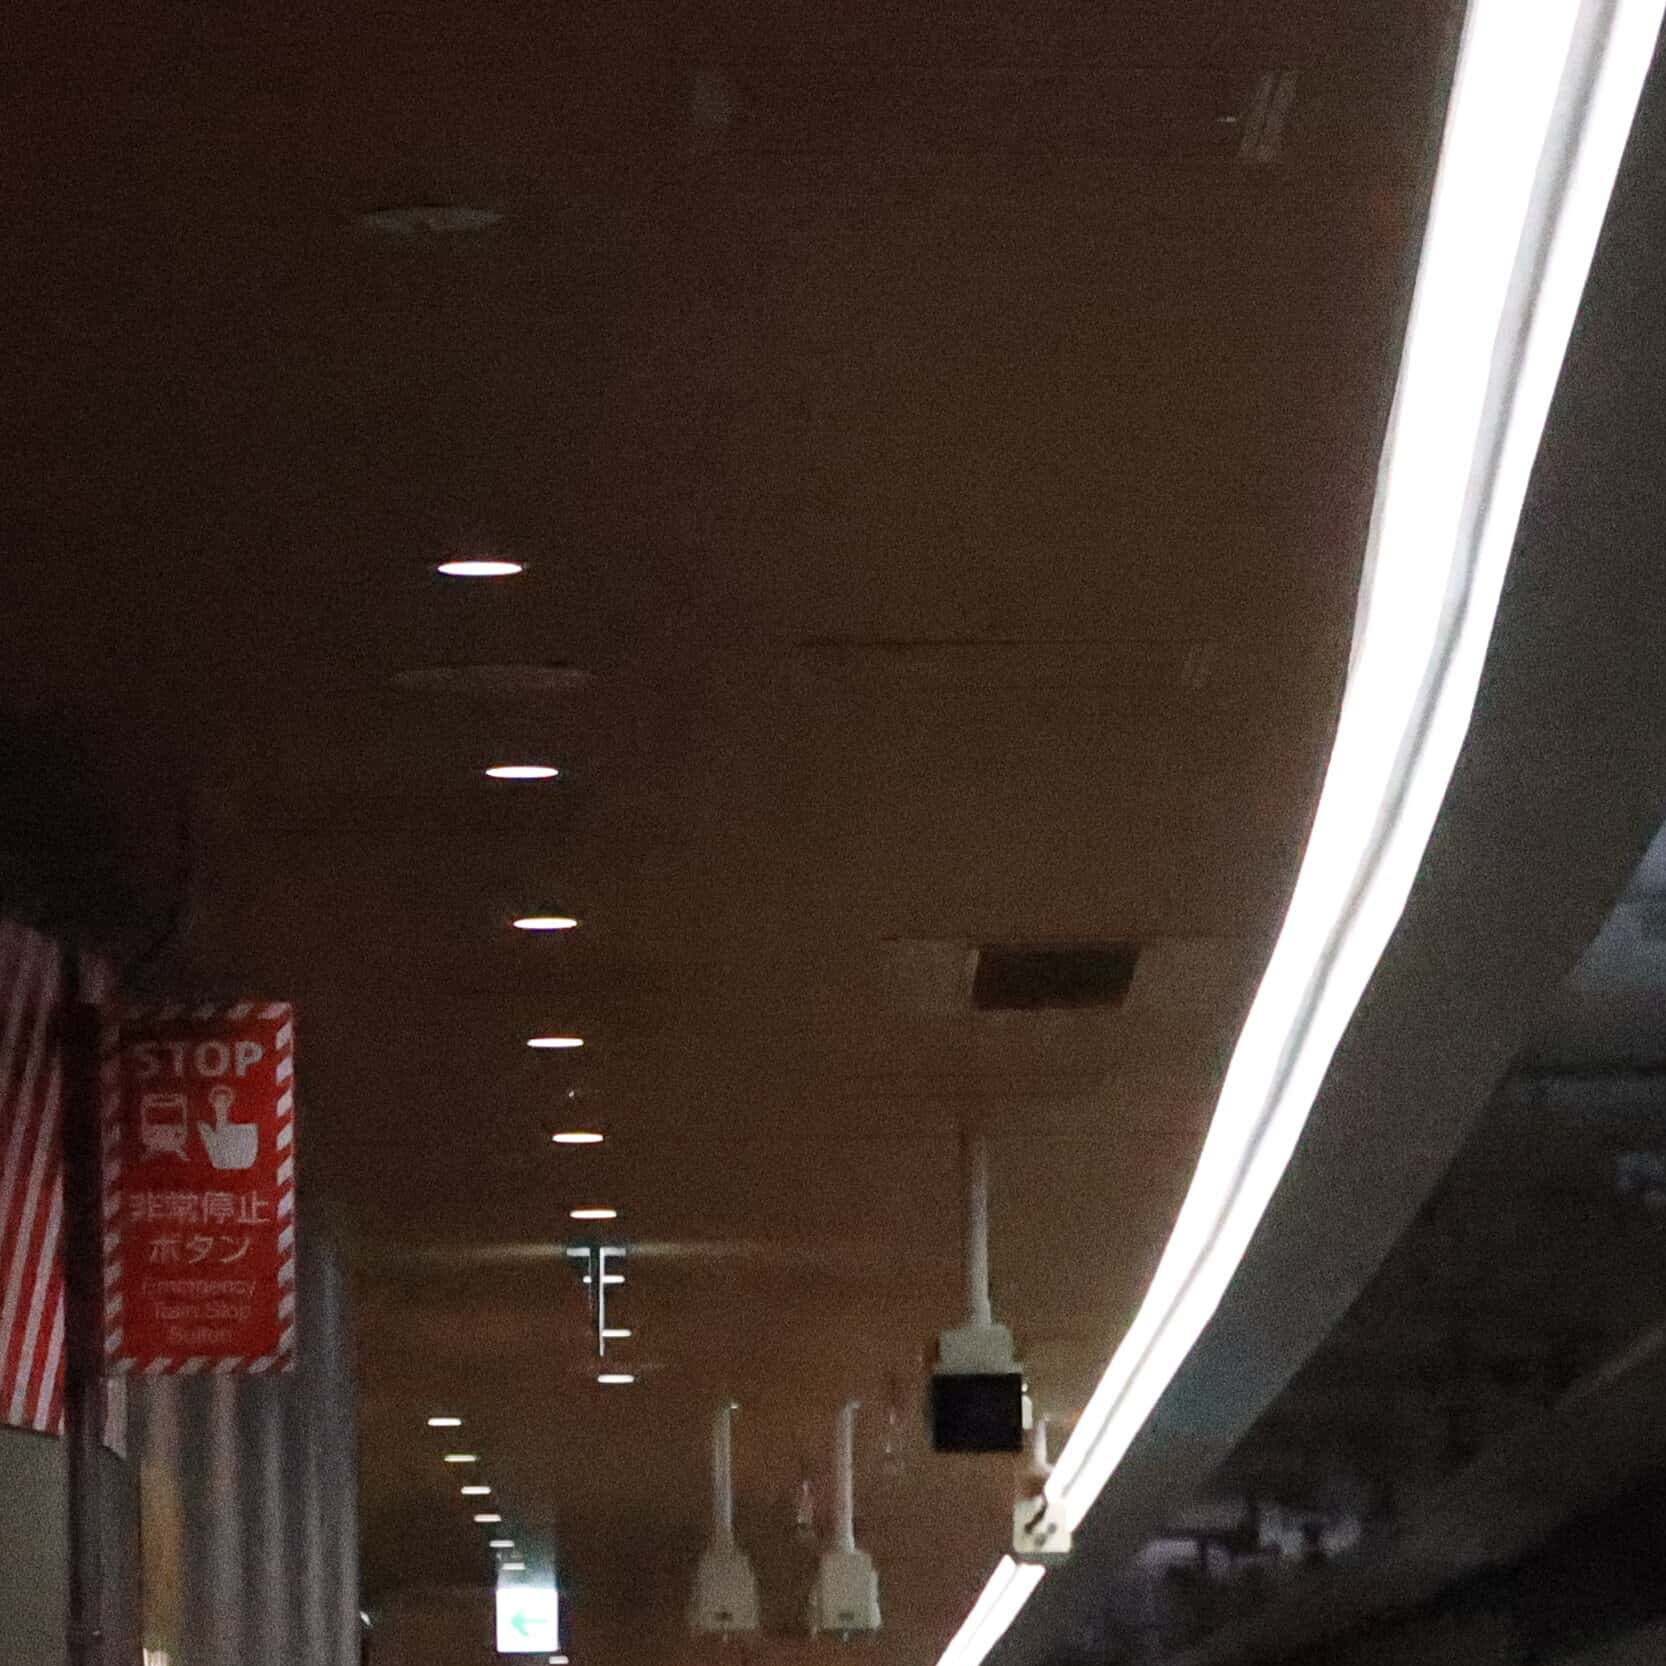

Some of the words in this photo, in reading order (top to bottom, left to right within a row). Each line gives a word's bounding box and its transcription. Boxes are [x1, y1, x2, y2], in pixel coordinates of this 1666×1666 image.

[134, 1040, 264, 1078] STOP
[129, 1190, 271, 1225] 非常停止
[150, 1233, 252, 1264] ボタン
